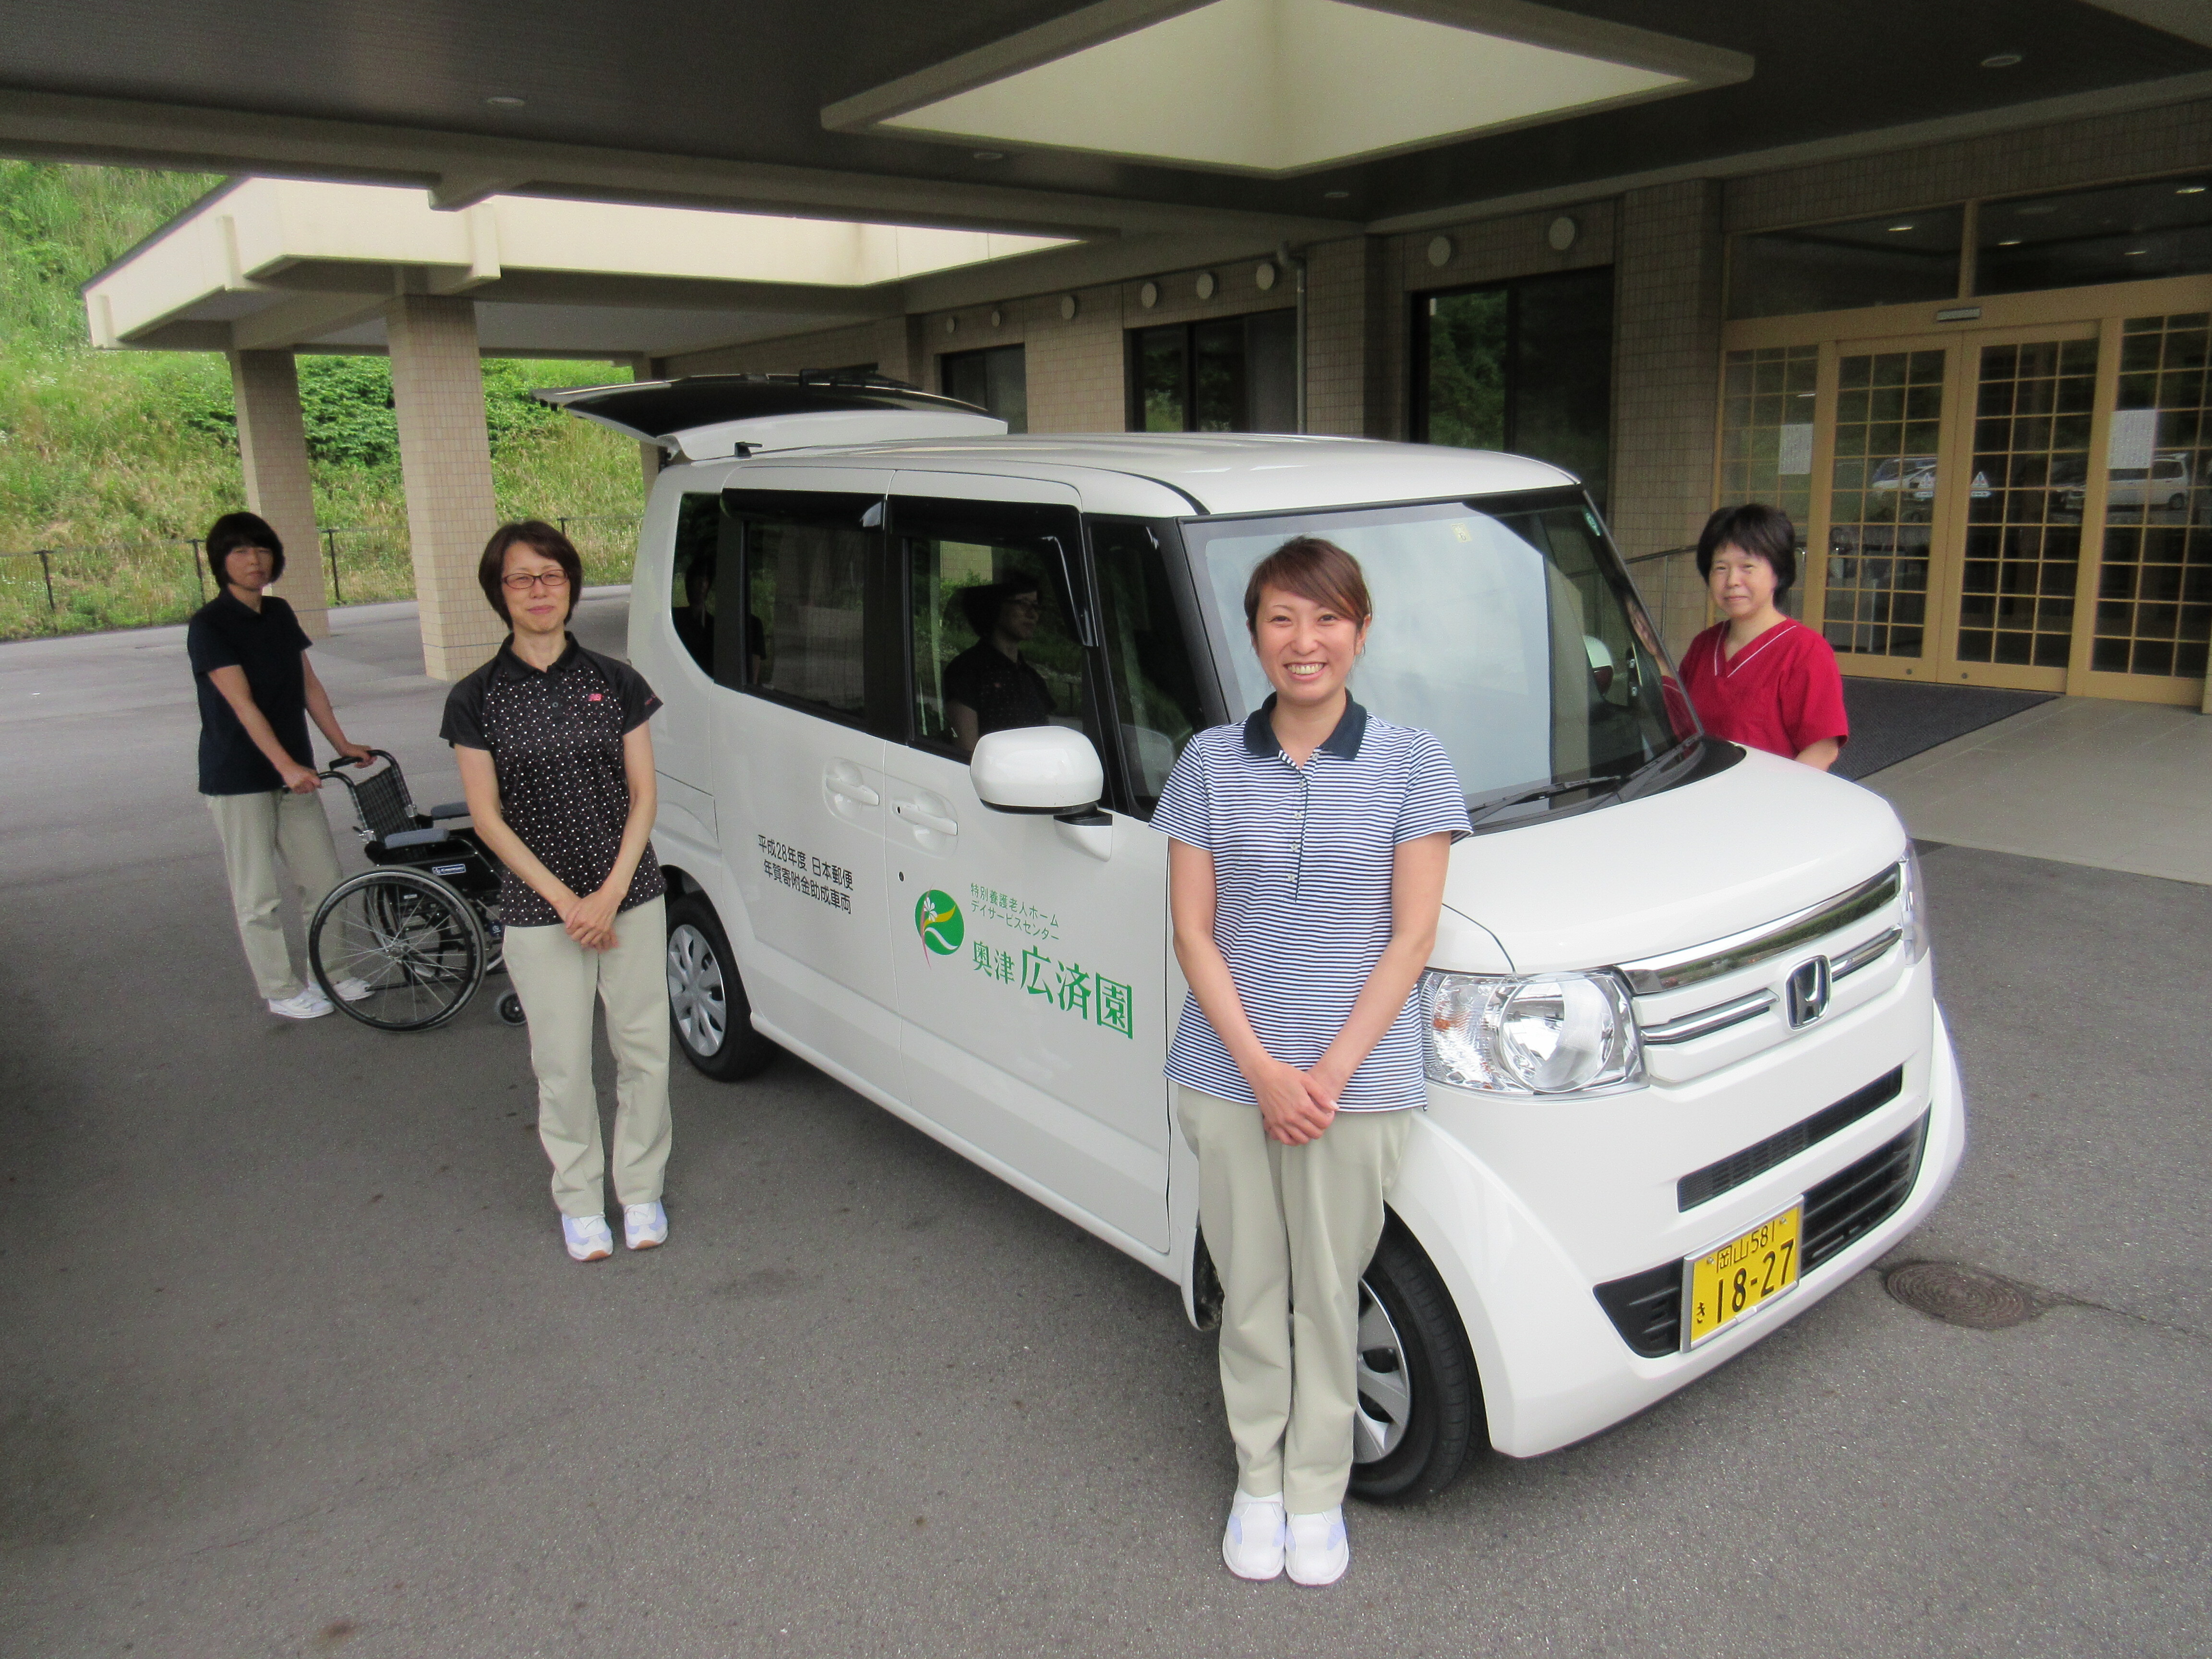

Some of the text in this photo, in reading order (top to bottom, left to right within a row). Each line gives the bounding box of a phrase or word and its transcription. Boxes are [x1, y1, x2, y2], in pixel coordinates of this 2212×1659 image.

[758, 834, 854, 891] 平成28年度 日本郵便
[764, 859, 852, 914] 年賀寄附金助成車両
[971, 882, 1059, 928] 特別養護老人ホーム
[971, 900, 1059, 940] デイサービスセンター
[1717, 1238, 1794, 1324] 18-27
